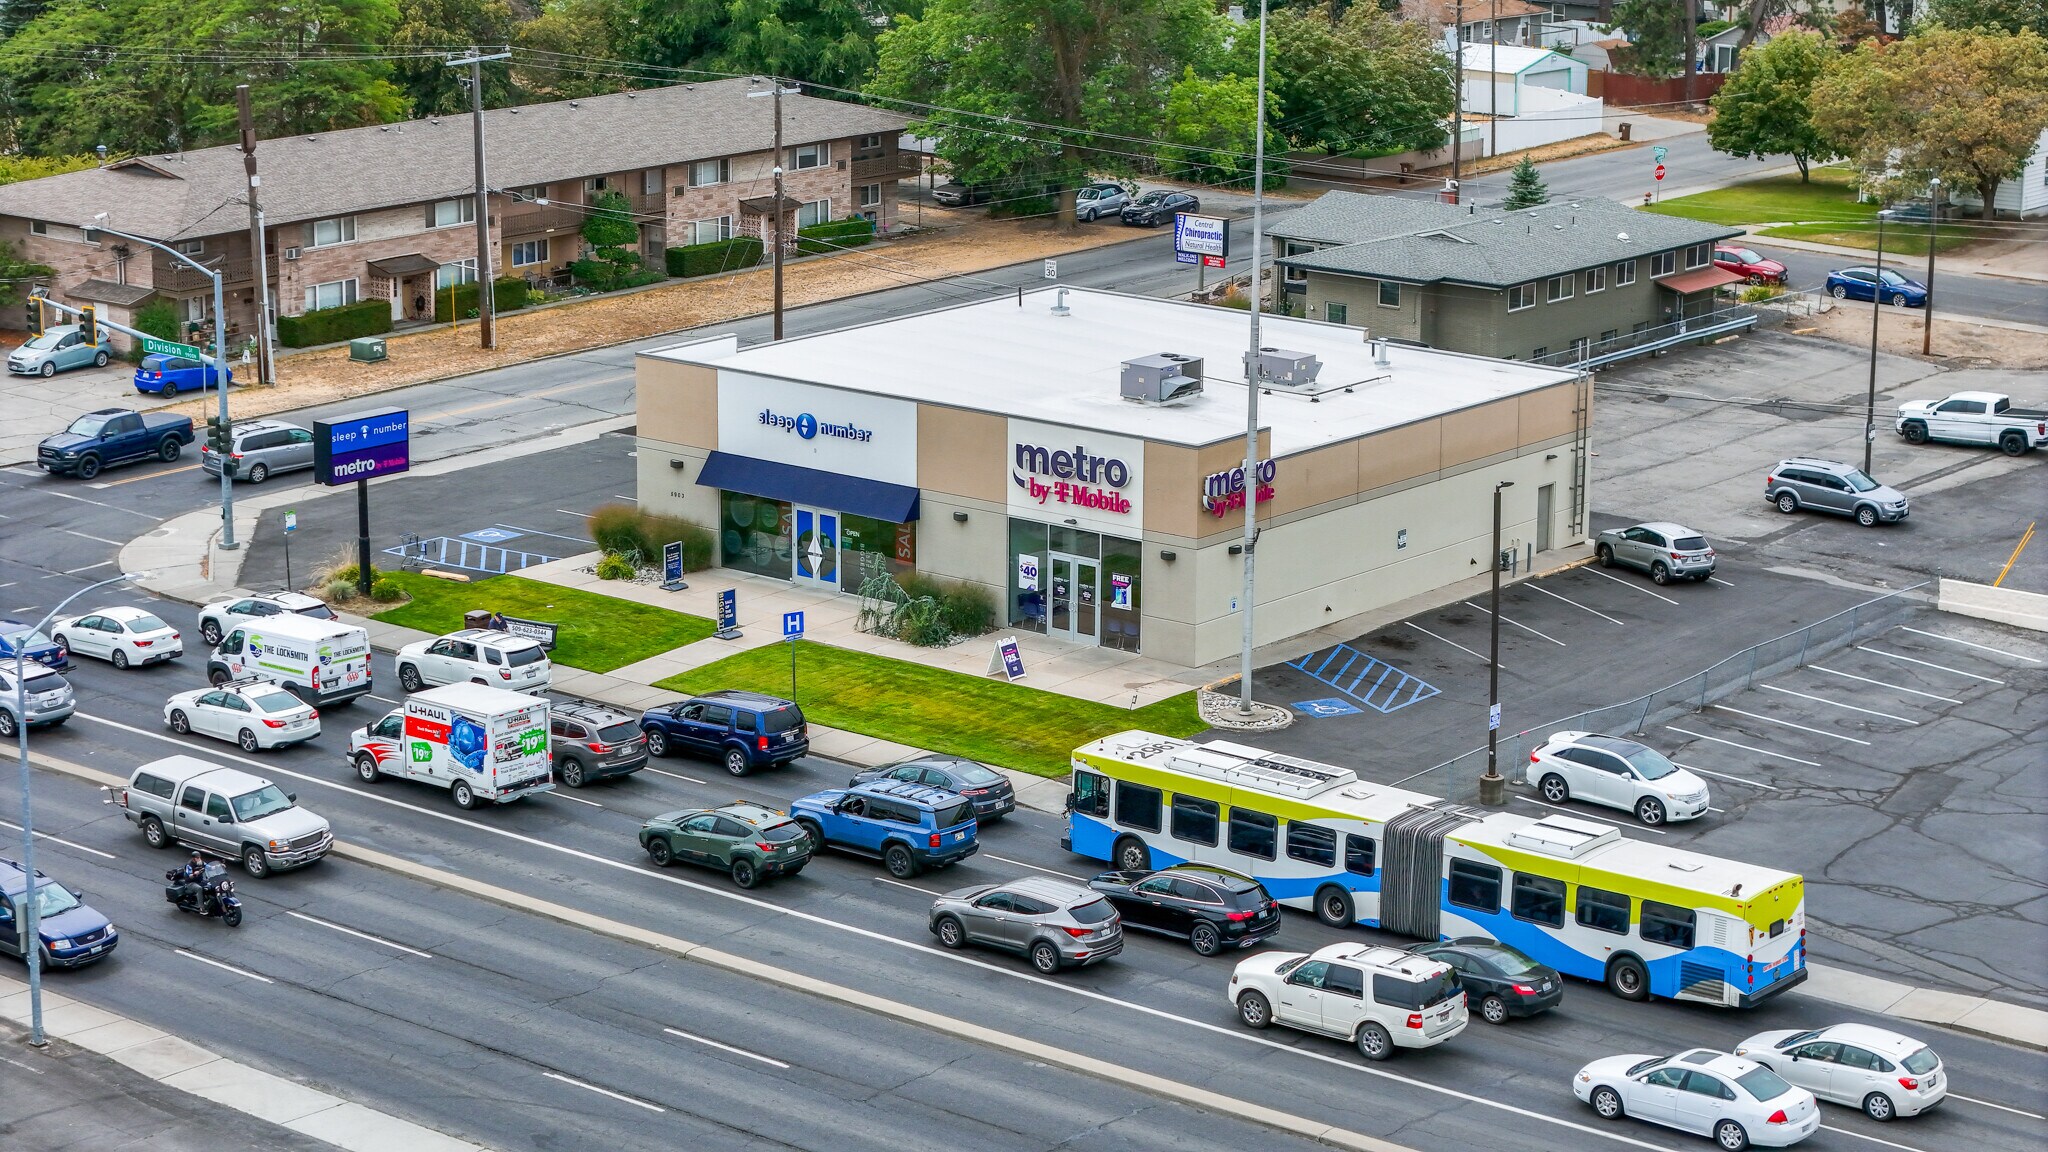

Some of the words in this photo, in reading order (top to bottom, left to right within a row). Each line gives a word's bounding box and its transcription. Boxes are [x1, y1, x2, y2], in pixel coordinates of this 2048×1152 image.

[1194, 220, 1214, 229] Central
[1184, 227, 1223, 241] Chiropractic
[1184, 240, 1204, 249] Natural
[1205, 243, 1222, 252] Health
[1046, 269, 1056, 277] 30
[148, 340, 182, 356] Division
[332, 432, 357, 442] sleep
[373, 422, 406, 435] number
[759, 408, 796, 433] sleep
[820, 422, 873, 442] number
[334, 458, 375, 477] metro
[1014, 443, 1130, 489] metro
[1029, 477, 1051, 504] by
[1019, 565, 1038, 577] $40
[1112, 574, 1130, 583] FREE
[512, 625, 547, 636] 509-623-0344
[787, 614, 800, 633] H
[263, 644, 275, 655] THE
[276, 647, 309, 662] LOCKSMITH
[333, 650, 342, 658] THE
[342, 646, 365, 656] LOCKSMITH
[409, 704, 447, 721] U-HAUL
[507, 713, 531, 725] U-HAUL
[1130, 741, 1184, 759] 2961
